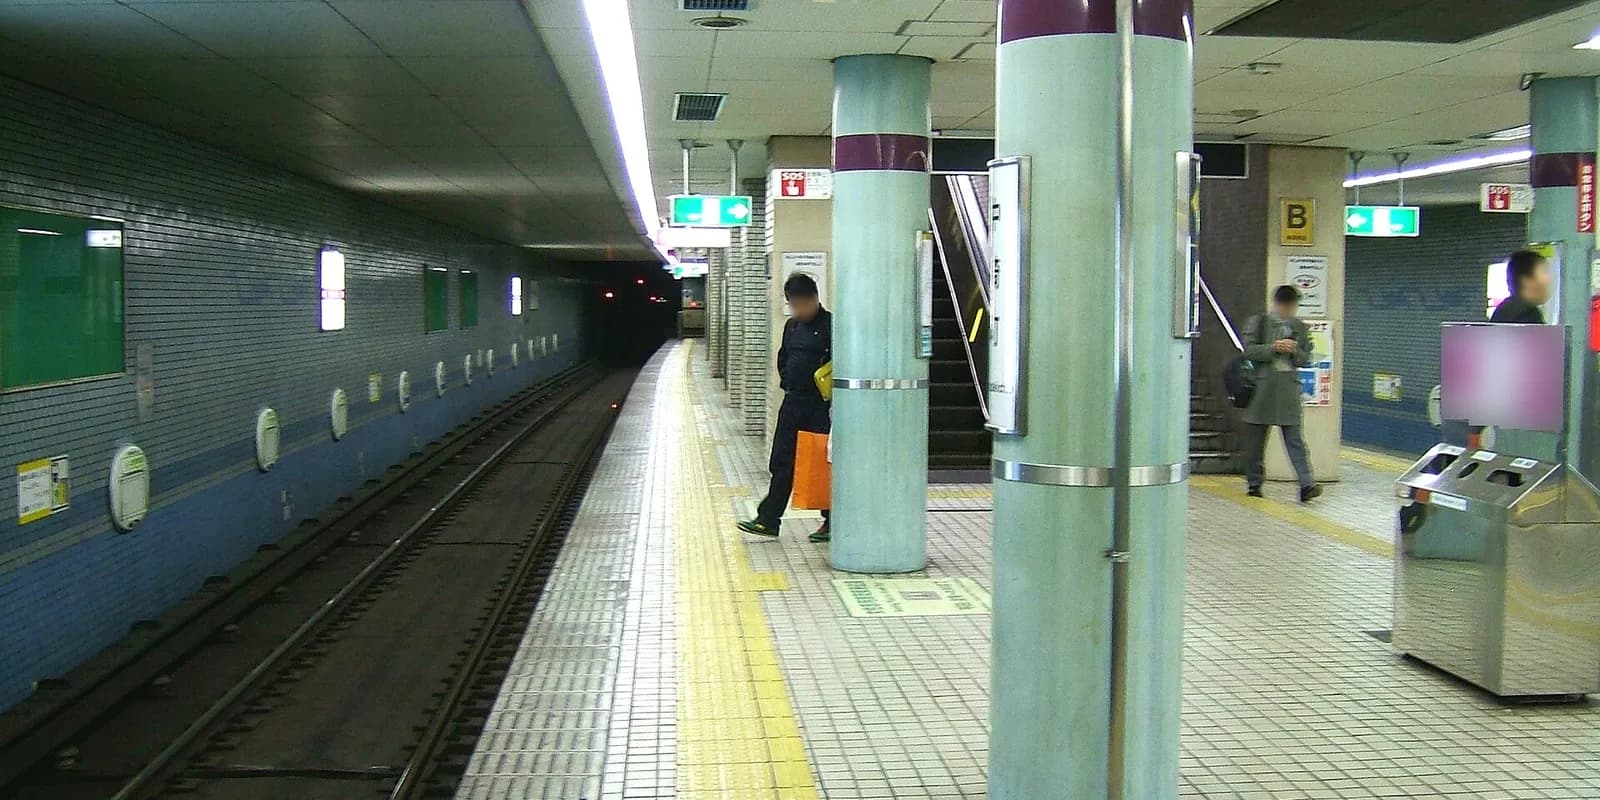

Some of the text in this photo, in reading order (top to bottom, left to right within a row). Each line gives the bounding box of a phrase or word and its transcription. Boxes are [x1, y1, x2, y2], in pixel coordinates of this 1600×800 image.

[782, 172, 804, 181] SOS
[1490, 186, 1510, 194] SOS
[1287, 204, 1306, 229] B
